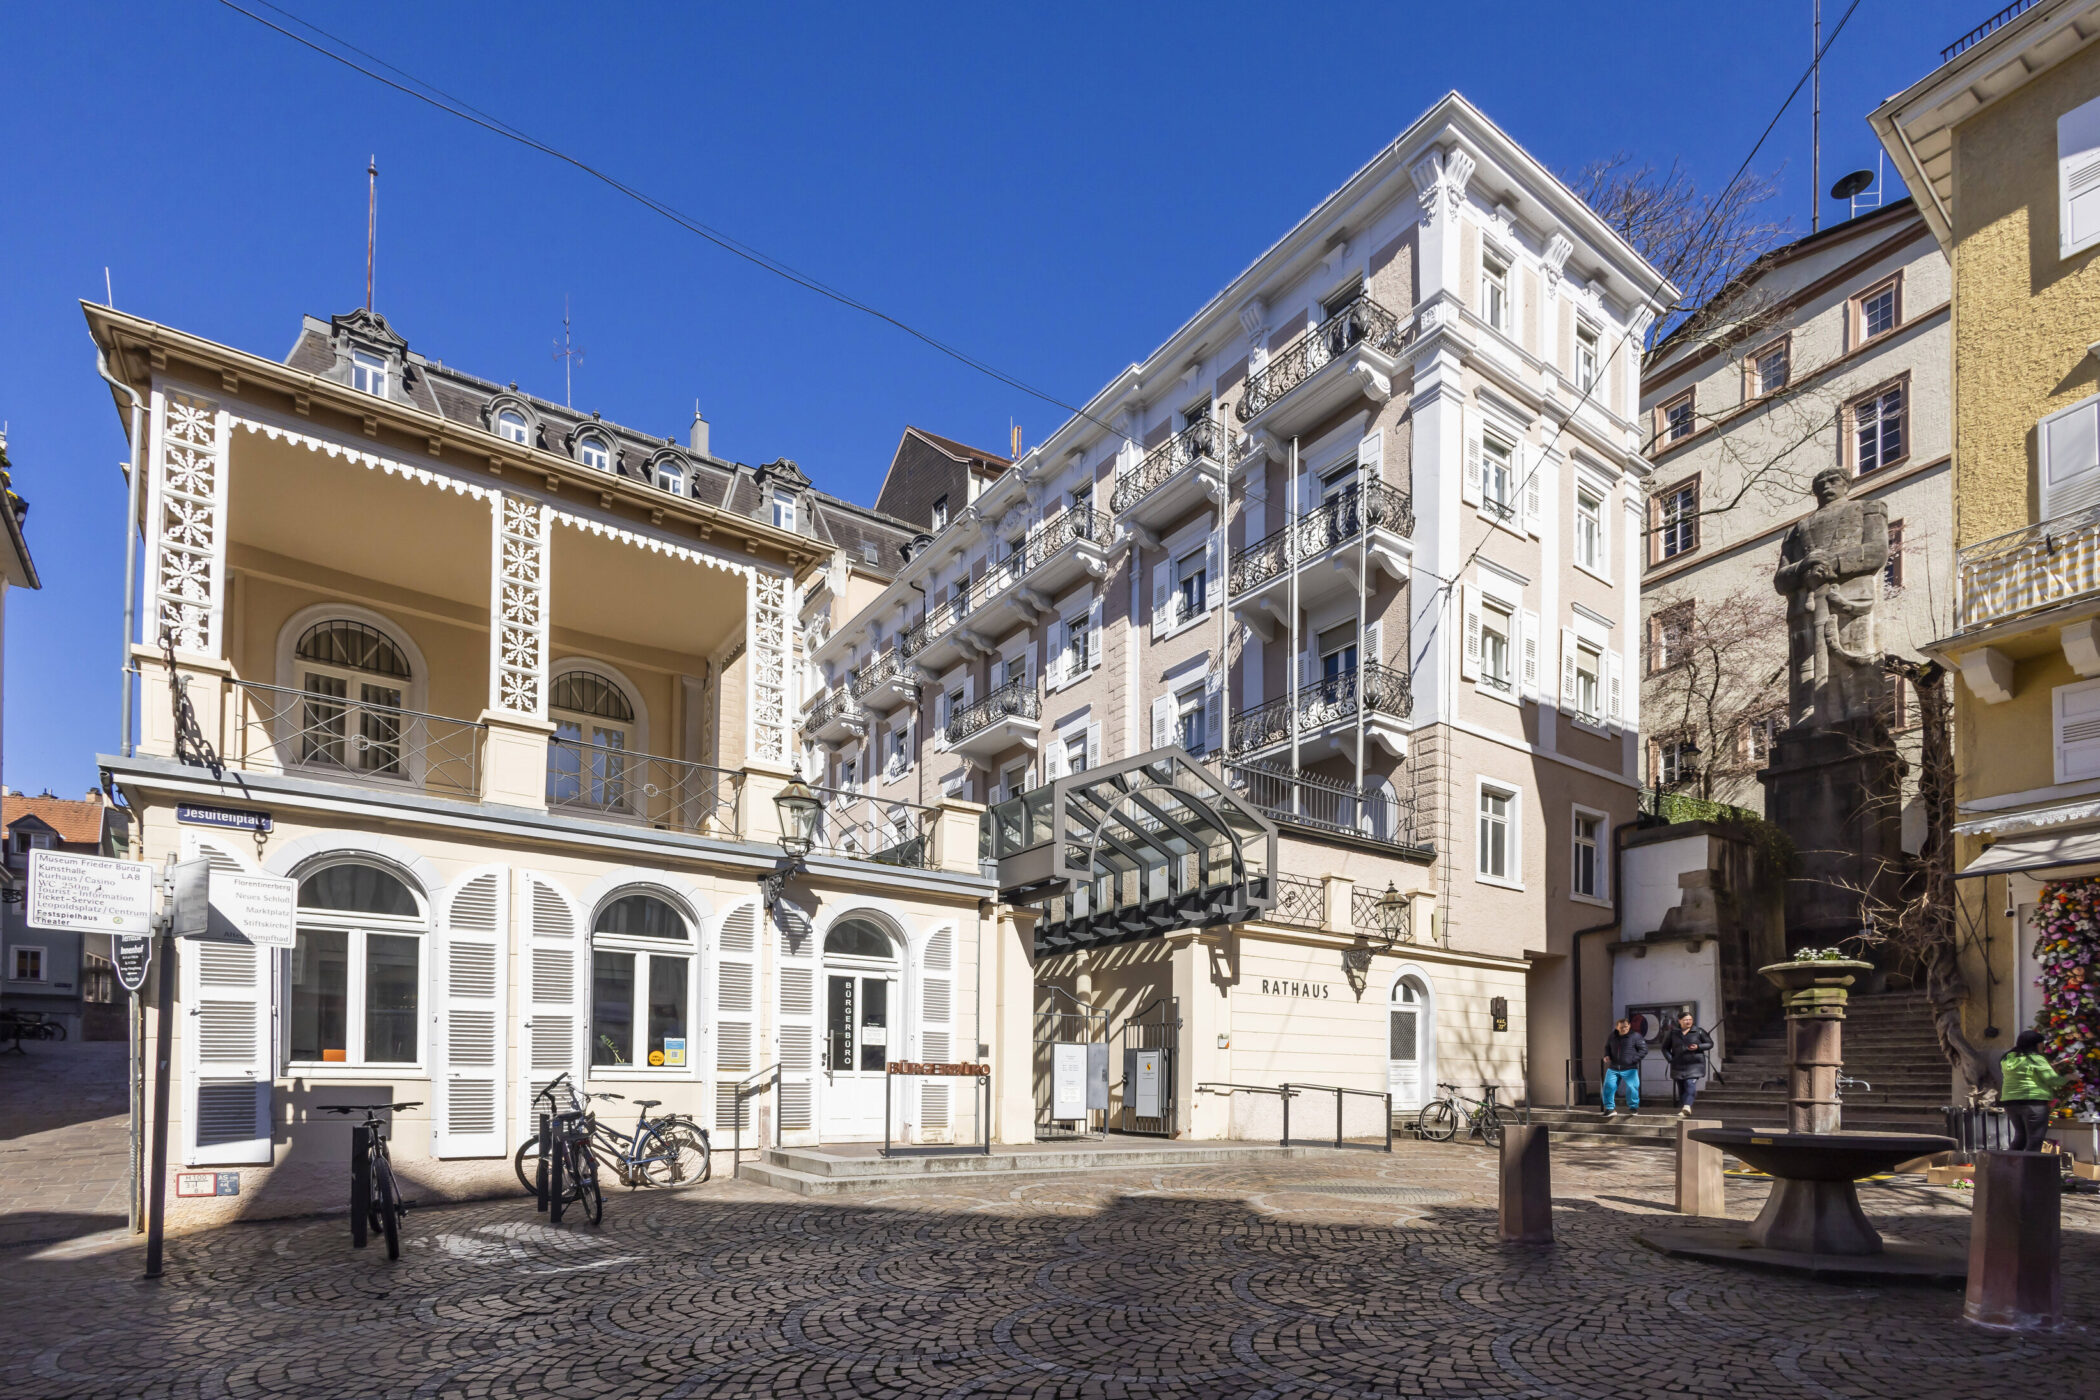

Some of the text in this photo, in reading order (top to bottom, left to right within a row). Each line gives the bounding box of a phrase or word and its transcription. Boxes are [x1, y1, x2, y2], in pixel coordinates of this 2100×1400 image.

[184, 806, 266, 826] Jesuitenplatz
[39, 855, 141, 873] Museum Frieder Burda
[39, 864, 86, 875] Kunsthalle
[38, 872, 78, 882] Kurhaus
[85, 876, 116, 886] Casino
[38, 879, 56, 888] WC
[234, 879, 291, 892] Florentinerberg
[80, 890, 134, 902] Information
[235, 892, 261, 901] Neues
[37, 901, 102, 914] Leopoldsplatz
[108, 907, 148, 917] Centrum
[246, 906, 290, 917] Marktplatz
[36, 917, 70, 926] Theater
[37, 910, 98, 922] Festspielhaus
[243, 920, 289, 930] Stiftskirche
[247, 932, 289, 943] Dampfbad
[1262, 979, 1329, 999] RATHAUS
[844, 981, 852, 1065] BÜRGERBÜRO
[887, 1059, 991, 1076] BÜRGERBÜRO
